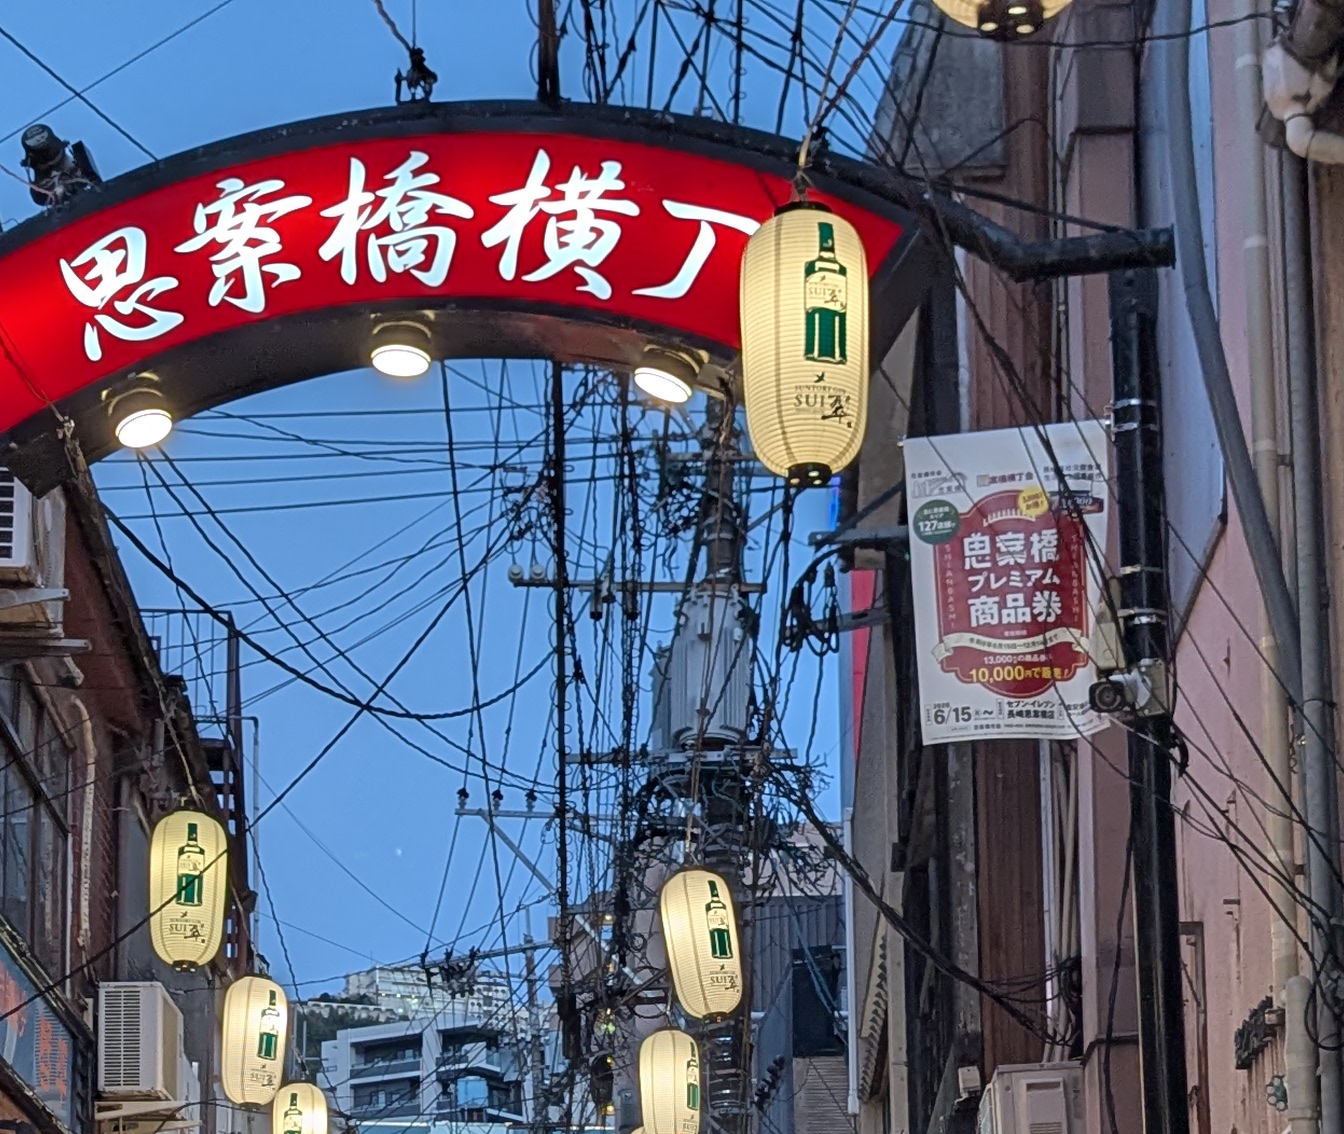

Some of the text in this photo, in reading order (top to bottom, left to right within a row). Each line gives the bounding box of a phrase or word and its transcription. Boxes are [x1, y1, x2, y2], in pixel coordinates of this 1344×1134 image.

[59, 150, 761, 361] 思案橋横丁
[794, 394, 824, 407] SUI
[967, 568, 1060, 592] プレミアム
[967, 590, 1062, 627] 商品券
[934, 706, 972, 725] 6/15
